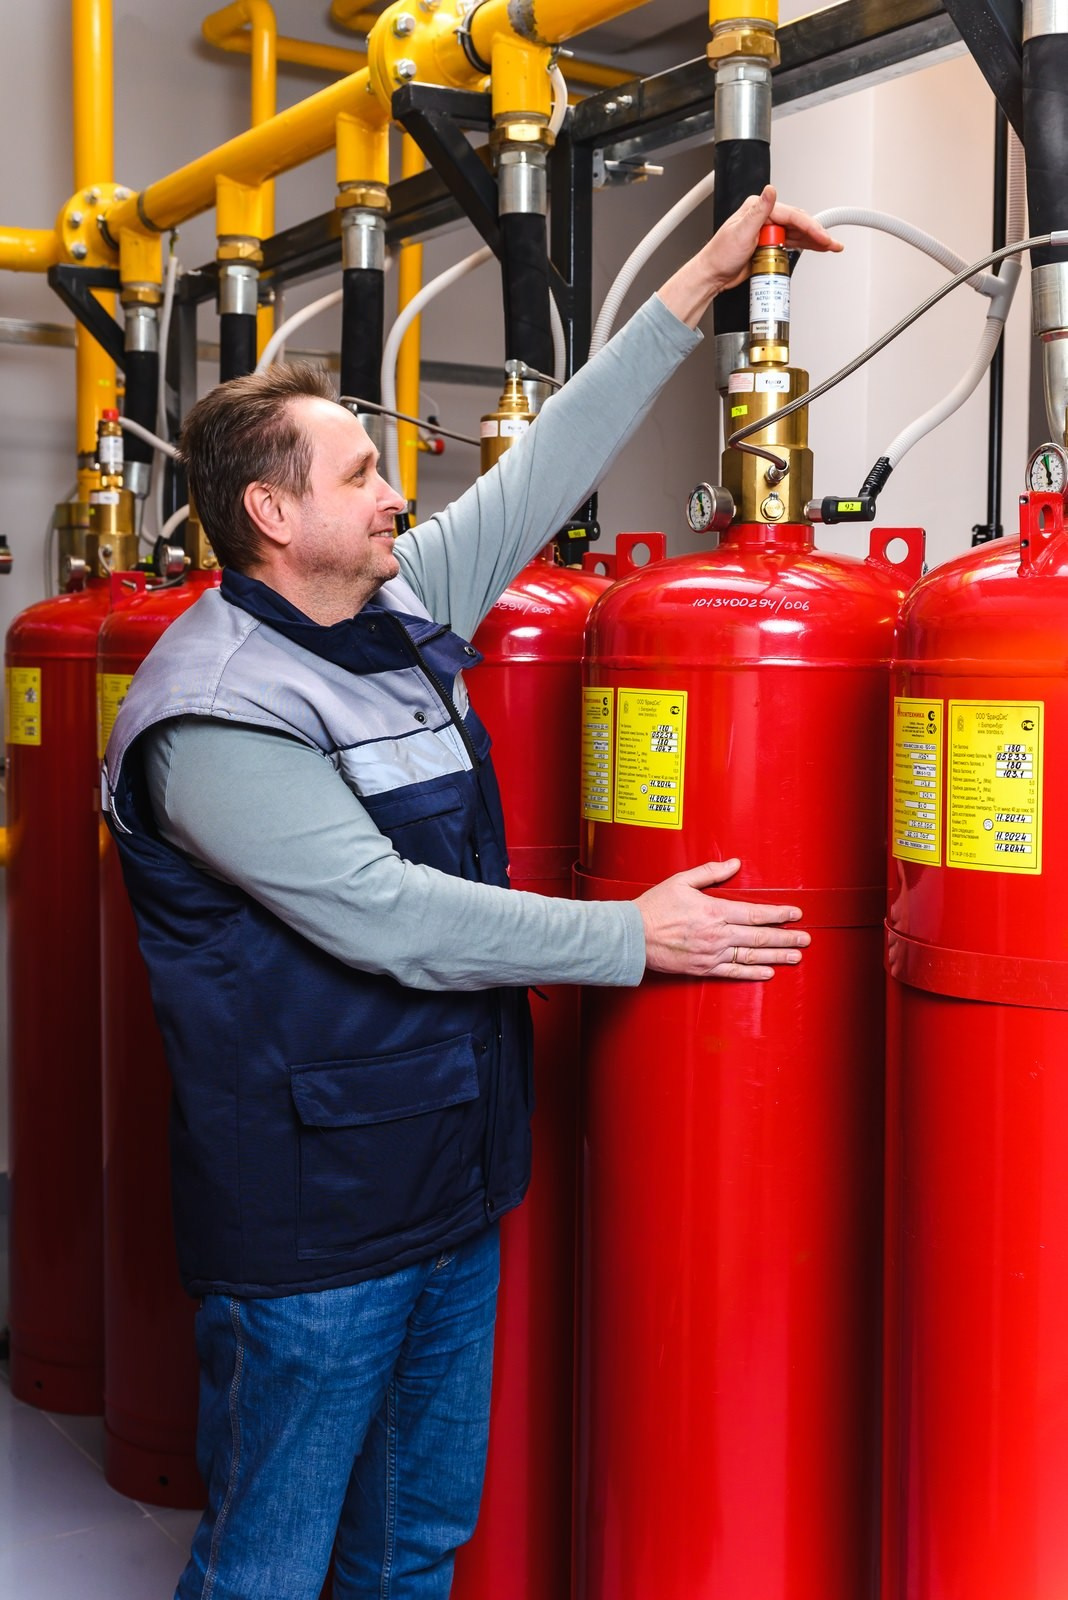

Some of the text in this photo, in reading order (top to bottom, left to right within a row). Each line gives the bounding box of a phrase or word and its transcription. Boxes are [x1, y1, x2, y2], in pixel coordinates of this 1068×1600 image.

[844, 502, 854, 511] 92
[691, 596, 810, 614] 1013400294/006
[1007, 744, 1021, 753] 180
[996, 752, 1027, 761] 05233
[1006, 761, 1022, 770] 180
[1003, 769, 1025, 778] 103.1
[996, 813, 1026, 824] 11.2014
[996, 831, 1027, 842] 11.2024
[996, 843, 1026, 854] 11.2044
